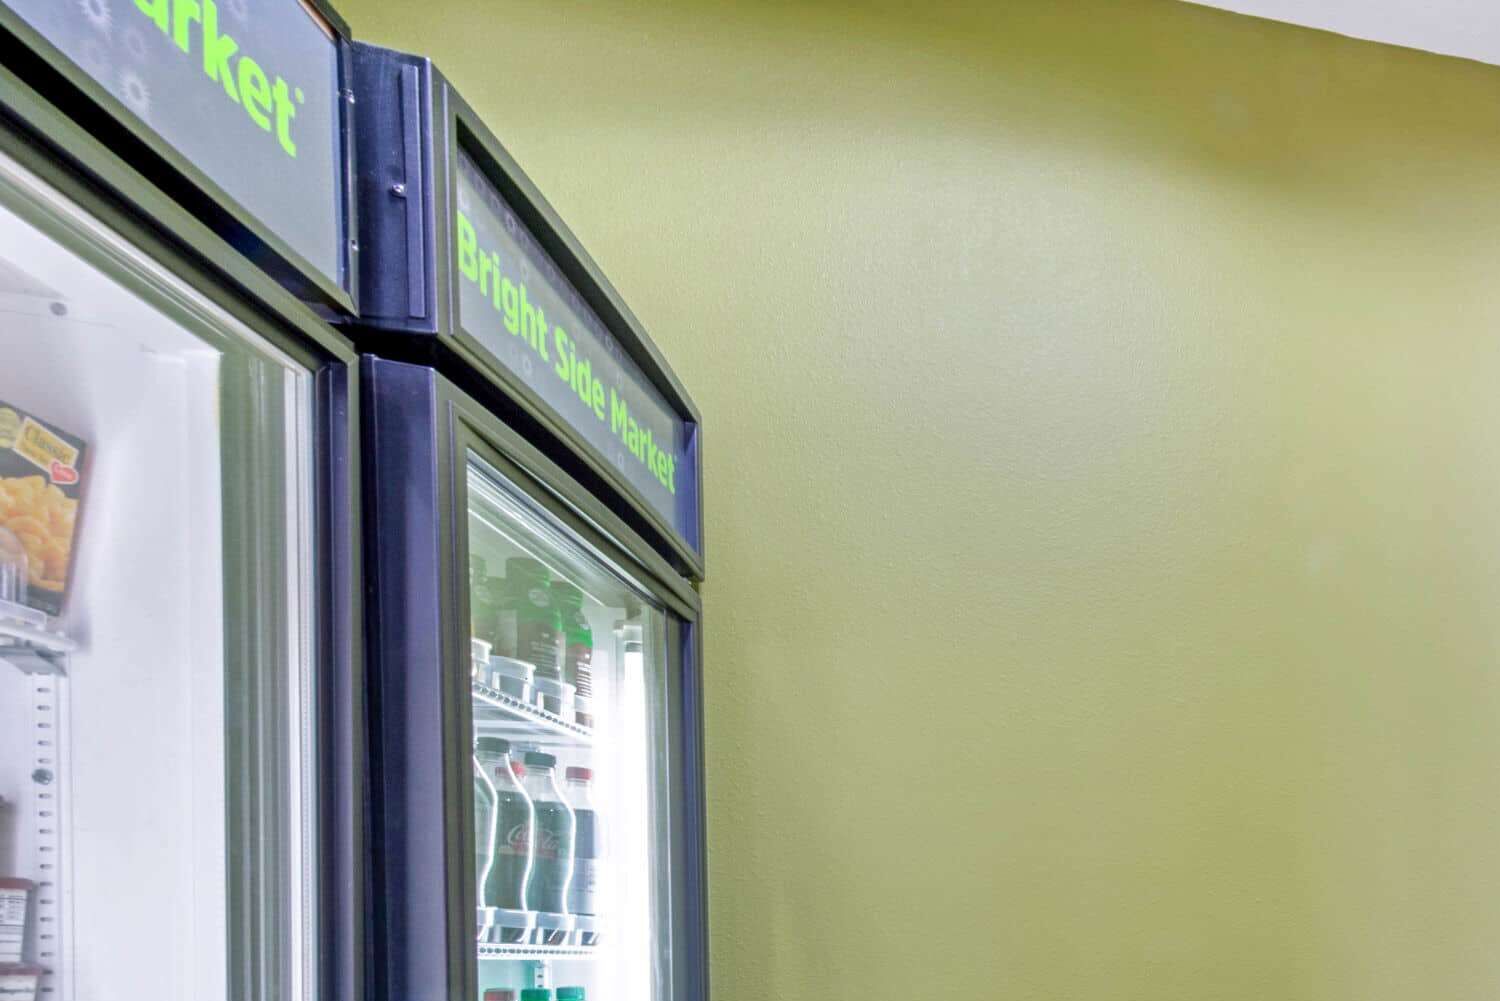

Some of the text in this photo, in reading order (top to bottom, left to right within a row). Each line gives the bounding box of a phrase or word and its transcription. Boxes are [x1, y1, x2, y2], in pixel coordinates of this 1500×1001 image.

[457, 210, 676, 496] Bright Side Market
